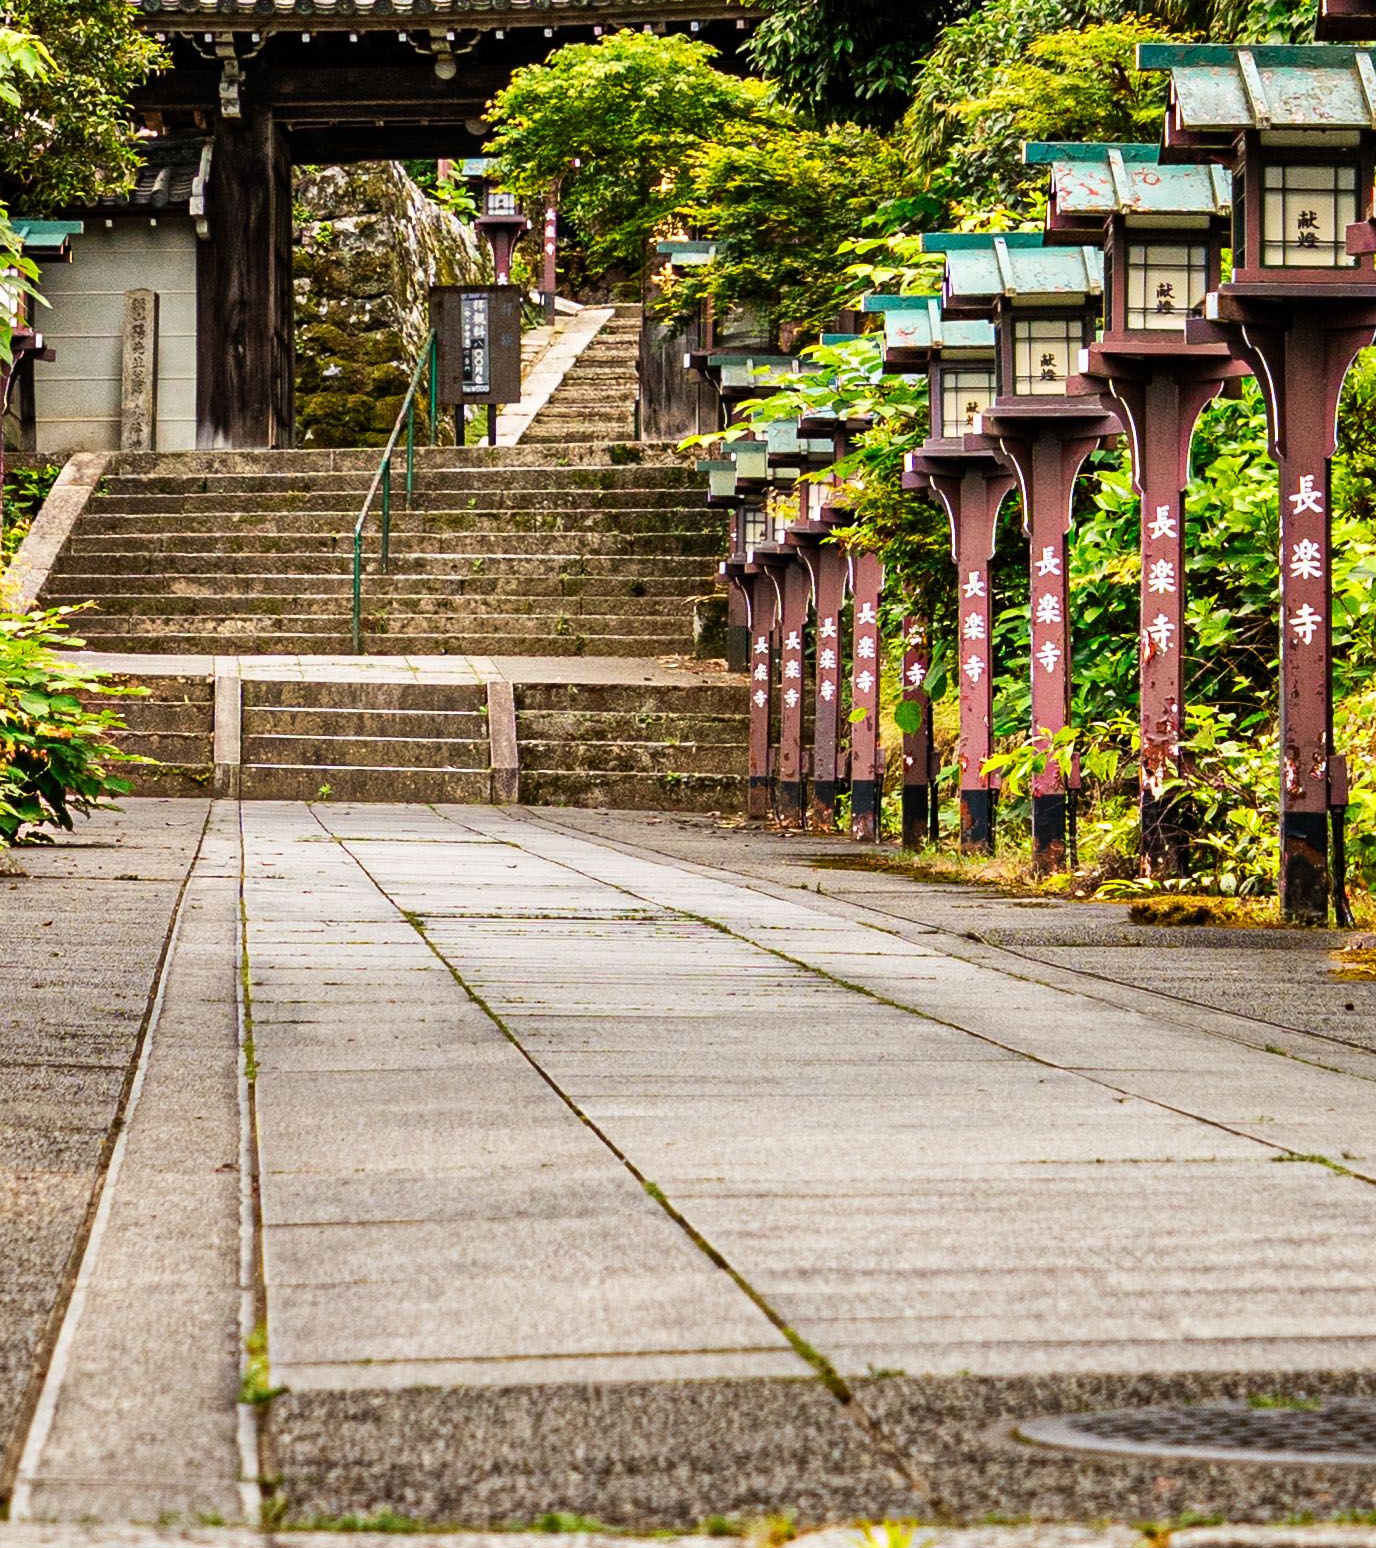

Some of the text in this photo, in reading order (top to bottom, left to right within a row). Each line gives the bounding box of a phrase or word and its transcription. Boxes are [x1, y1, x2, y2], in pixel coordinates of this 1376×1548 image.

[1296, 210, 1321, 249] 献燈
[1147, 504, 1177, 656] 長楽寺
[1288, 474, 1324, 645] 長楽寺
[856, 602, 876, 694] 長楽寺
[962, 570, 986, 682] 長楽寺
[1035, 545, 1062, 673] 長楽寺
[753, 635, 769, 708] 長楽寺
[784, 630, 801, 708] 長楽寺
[820, 617, 837, 702] 長楽寺
